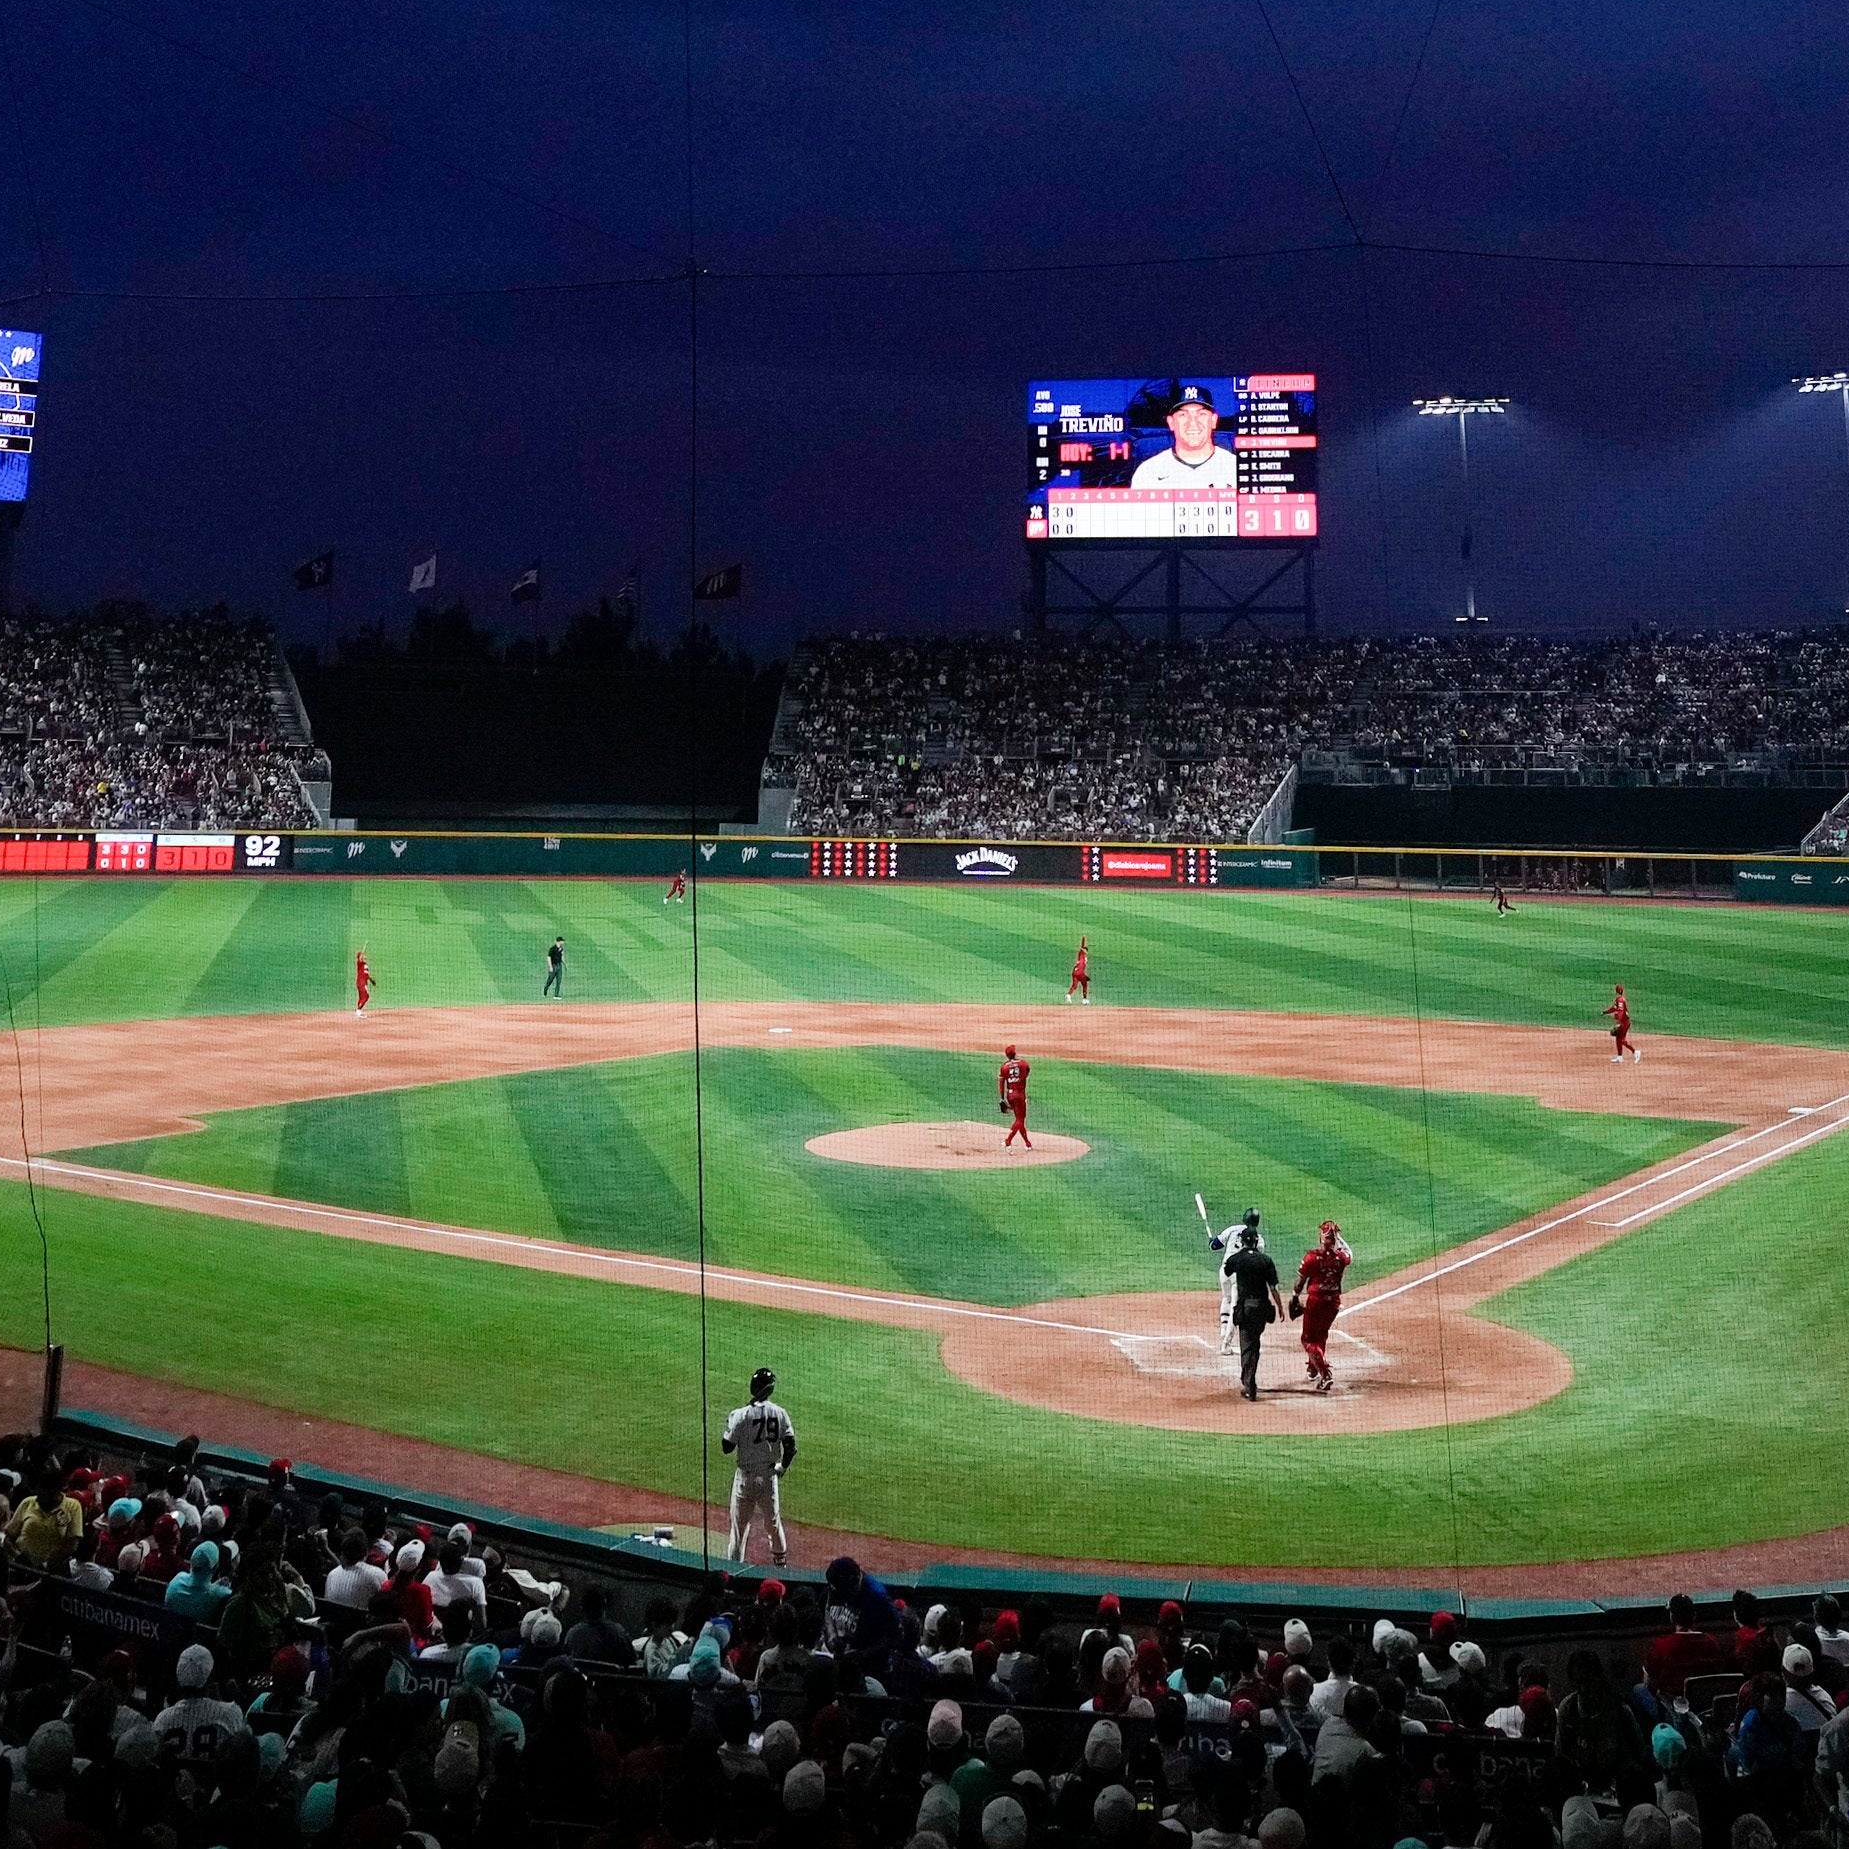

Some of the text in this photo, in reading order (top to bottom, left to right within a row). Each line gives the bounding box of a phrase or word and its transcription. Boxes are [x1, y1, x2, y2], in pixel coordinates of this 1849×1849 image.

[1256, 378, 1311, 388] LINEUP
[1259, 391, 1281, 399] VOLPE
[1060, 404, 1082, 417] JOSE
[1258, 402, 1289, 411] STANTON
[1059, 414, 1124, 433] TREVIÑO
[1258, 415, 1290, 423] CABRERA
[1259, 437, 1288, 446] TREVIÑO
[1060, 443, 1093, 462] HOY:
[1109, 442, 1130, 460] 1-1
[1259, 462, 1282, 470] SMITH
[1039, 469, 1048, 480] 2
[1052, 505, 1232, 518] 3 0 3 3 0 0
[1244, 509, 1310, 531] 3 1 0
[1052, 523, 1060, 534] 0
[1066, 523, 1074, 534] 0
[1179, 523, 1186, 534] 0
[1207, 523, 1215, 534] 0
[102, 845, 111, 855] 3
[120, 845, 130, 855] 3
[137, 845, 147, 855] 0
[245, 835, 281, 857] 92
[100, 858, 110, 869] 0
[121, 858, 128, 869] 1
[135, 858, 145, 869] 0
[164, 851, 175, 866] 3
[215, 851, 226, 866] 0
[246, 857, 276, 867] MPH
[955, 846, 1019, 873] JACK DANIEL'S
[752, 1417, 780, 1444] 79
[60, 1594, 160, 1641] citibanamex
